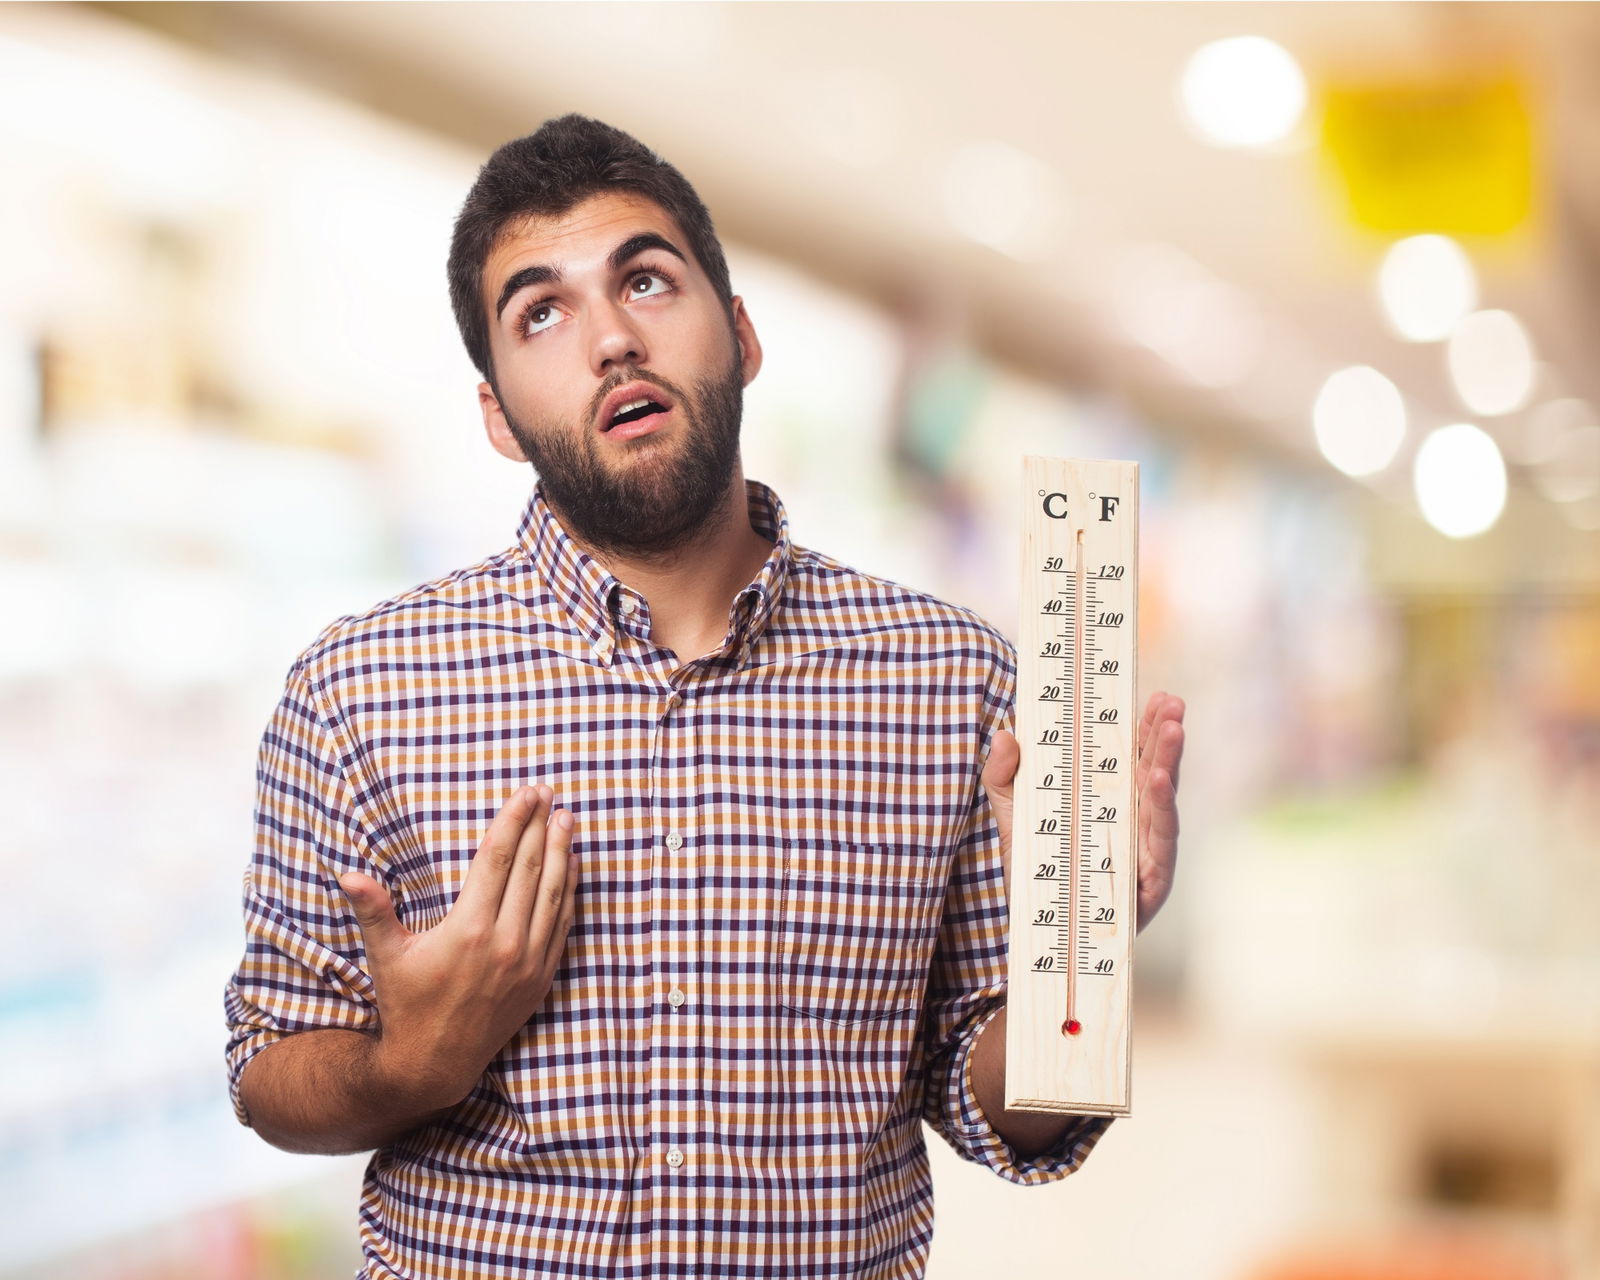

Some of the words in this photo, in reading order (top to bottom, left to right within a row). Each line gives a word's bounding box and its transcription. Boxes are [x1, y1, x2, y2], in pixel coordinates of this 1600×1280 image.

[1044, 557, 1063, 570] 50
[1098, 565, 1124, 578] 120
[1043, 600, 1062, 612] 40
[1097, 613, 1124, 625] 100
[1041, 642, 1061, 655] 30
[1099, 661, 1119, 673] 80
[1040, 686, 1060, 699] 20
[1099, 709, 1118, 721] 60
[1040, 730, 1059, 743] 10
[1098, 758, 1117, 770] 40
[1043, 774, 1053, 787] 0
[1096, 807, 1117, 820] 20
[1038, 819, 1057, 832] 10
[1101, 857, 1111, 870] 0
[1035, 864, 1056, 877] 20
[1034, 910, 1055, 923] 30
[1094, 908, 1115, 921] 20
[1034, 956, 1053, 970] 40
[1094, 959, 1114, 972] 40
